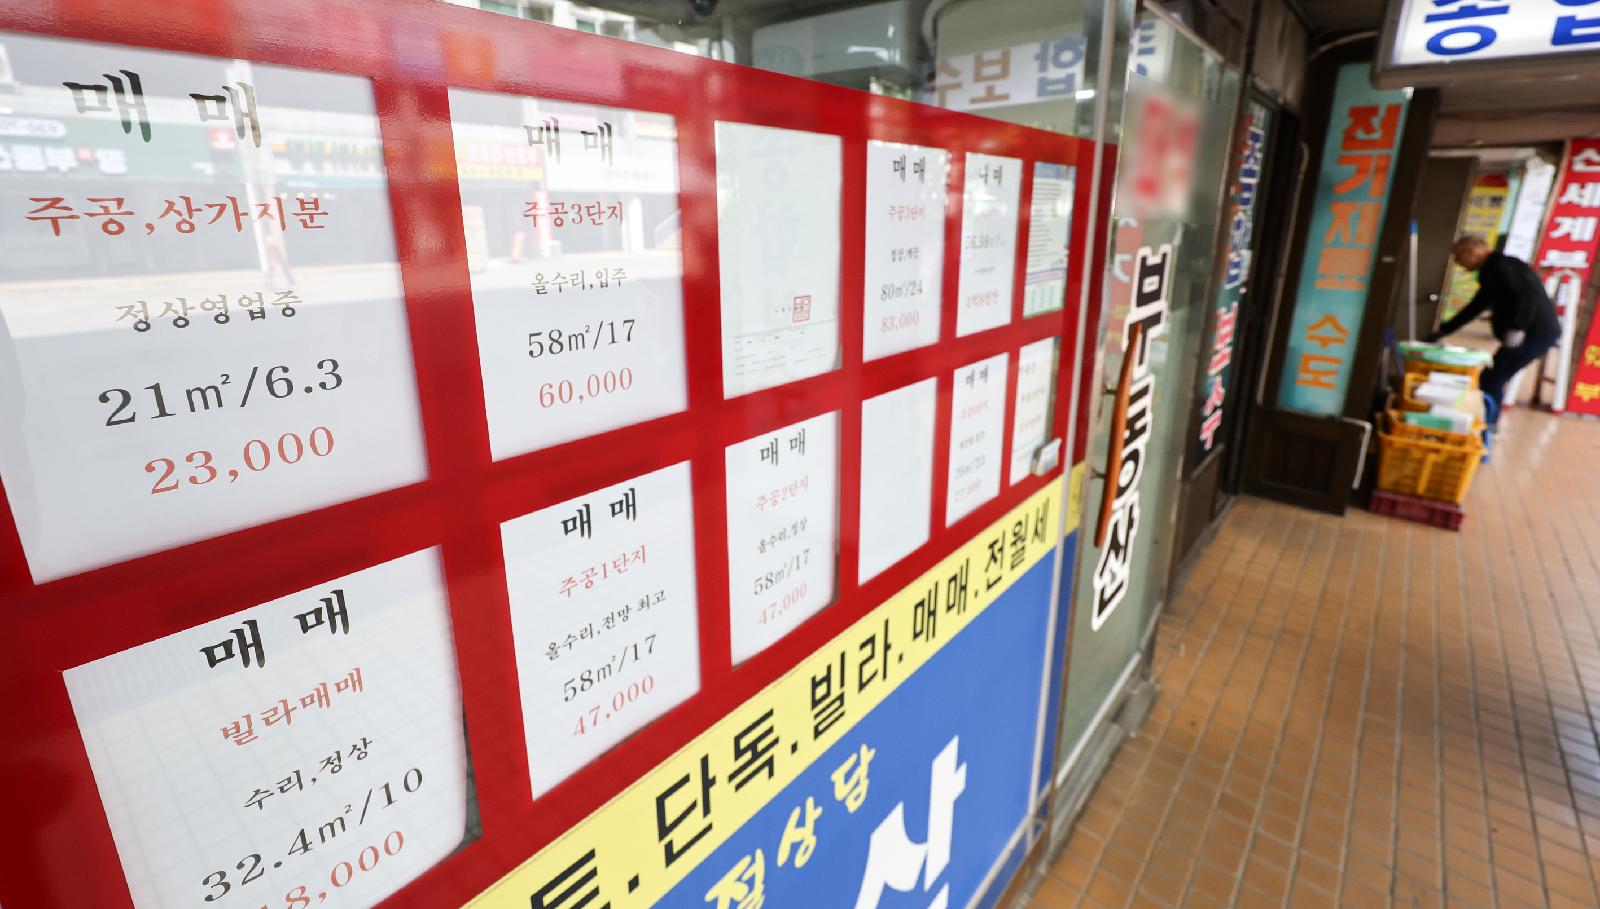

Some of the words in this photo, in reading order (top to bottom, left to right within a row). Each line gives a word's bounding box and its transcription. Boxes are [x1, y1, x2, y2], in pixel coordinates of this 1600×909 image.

[26, 194, 329, 237] 주공,상가지분
[523, 201, 625, 229] 주공3단지
[1315, 103, 1399, 291] 전기재료
[115, 289, 303, 333] 정상영업중
[530, 267, 628, 296] 올수리,입주
[1296, 314, 1350, 390] 수도
[539, 367, 633, 409] 60,000
[144, 426, 335, 495] 23,000
[559, 544, 647, 599] 주공1단지
[758, 582, 808, 627] 47,000
[219, 666, 364, 747] 빌라매매
[573, 674, 655, 738] 47,000
[243, 736, 374, 811] 수리,정상
[260, 830, 405, 909] 8,000
